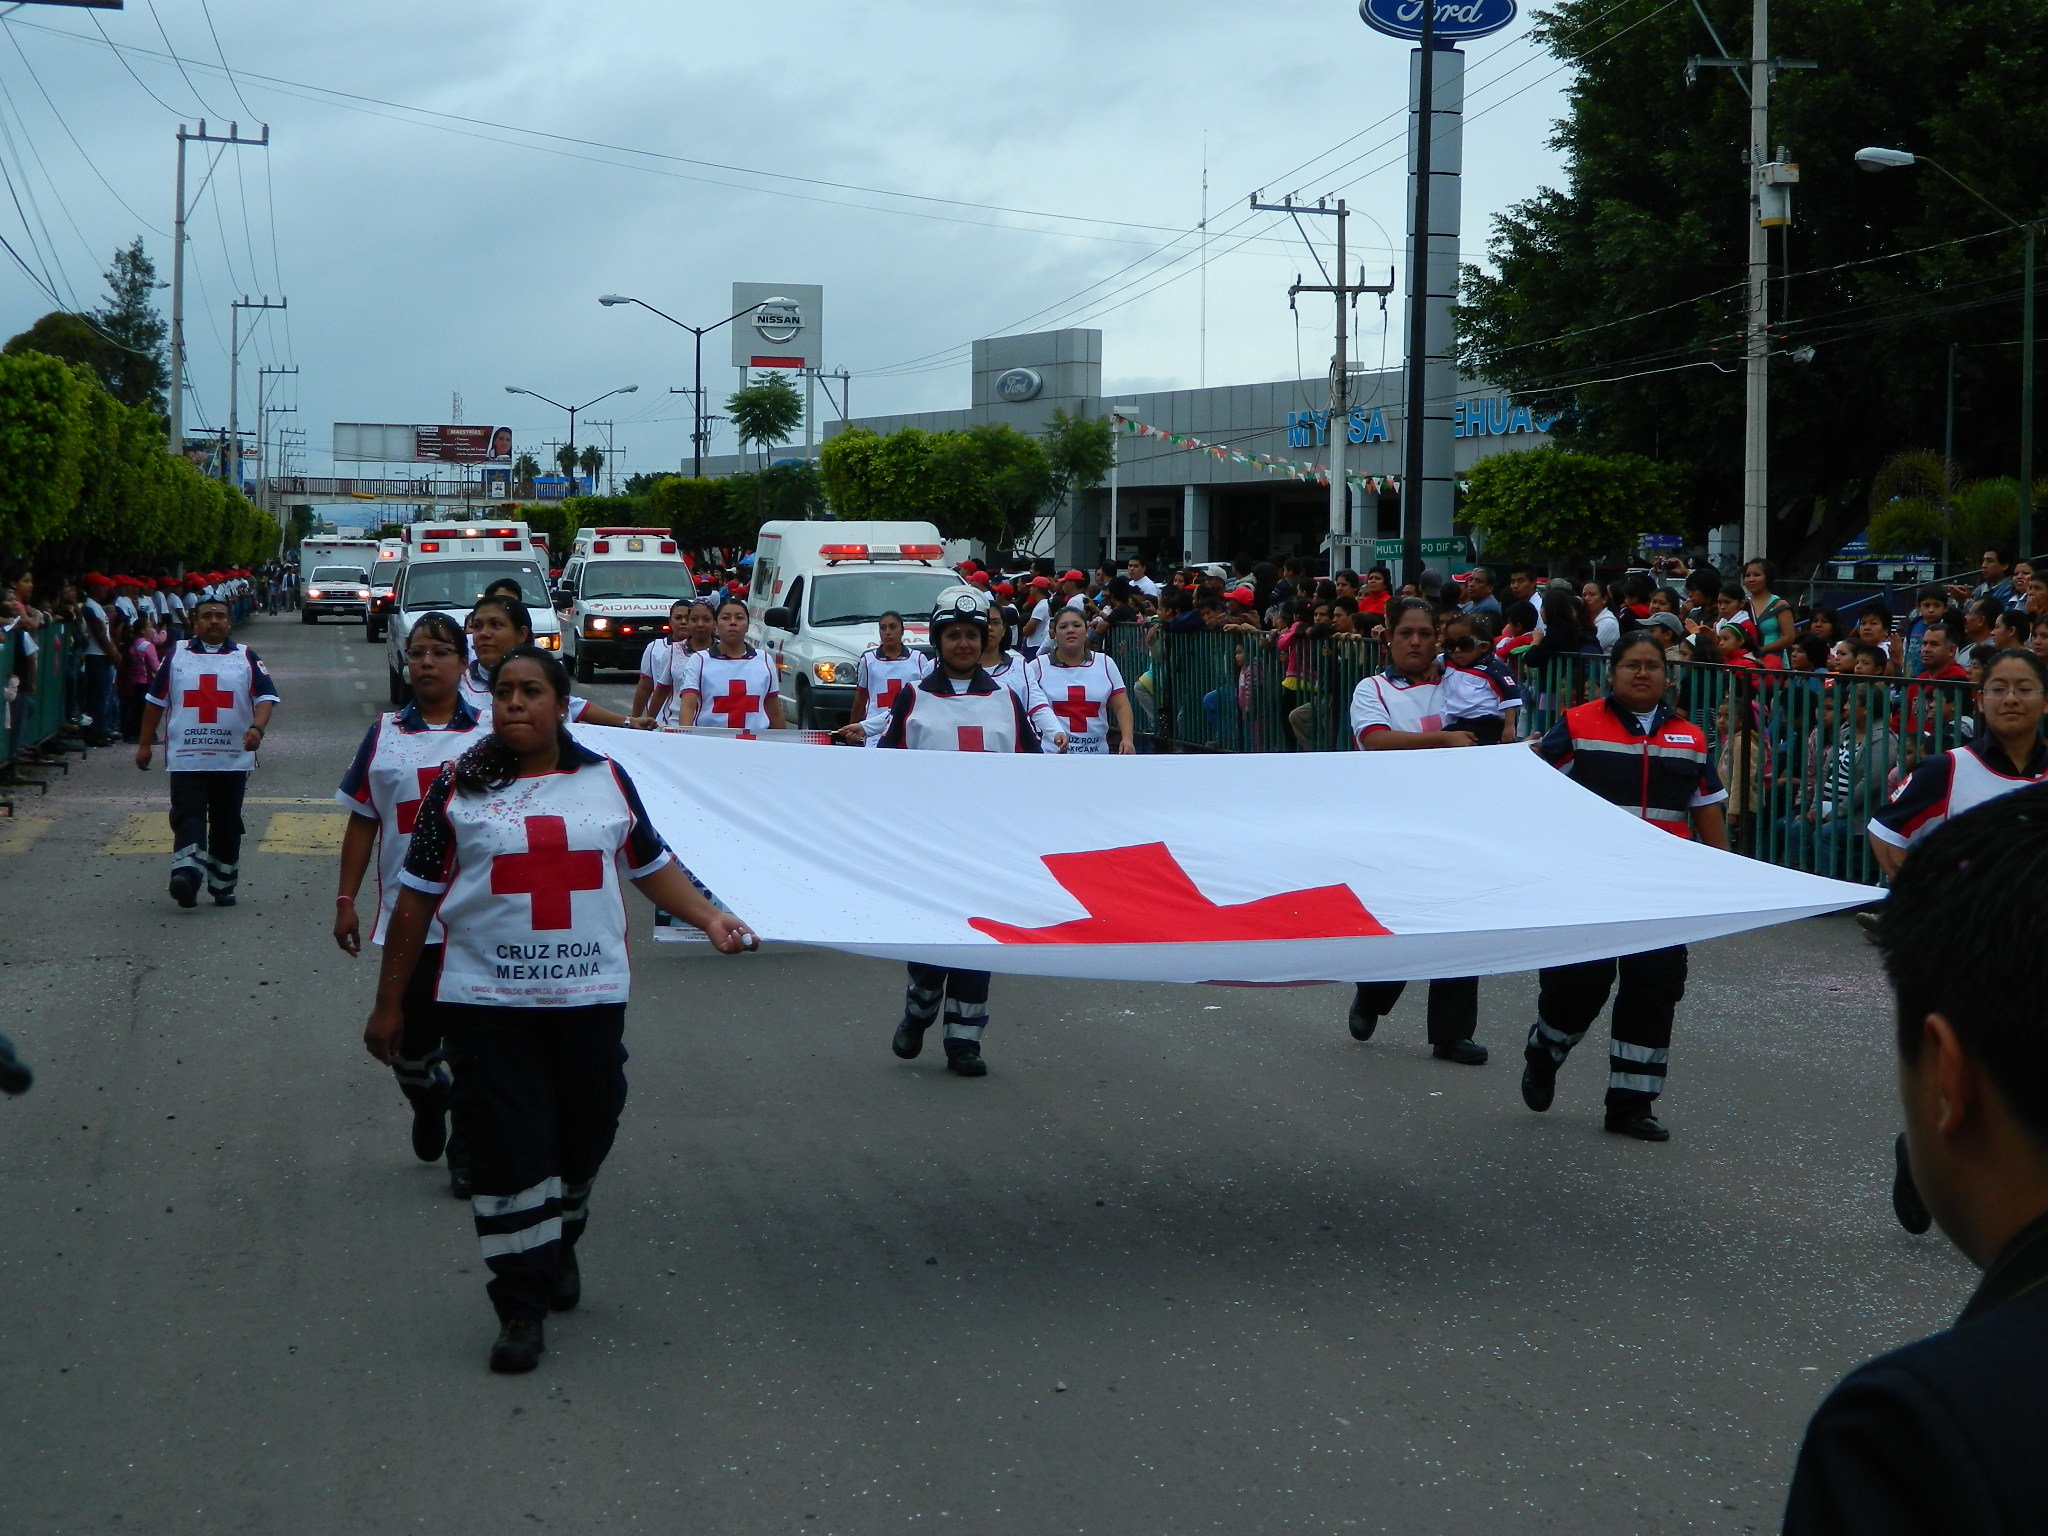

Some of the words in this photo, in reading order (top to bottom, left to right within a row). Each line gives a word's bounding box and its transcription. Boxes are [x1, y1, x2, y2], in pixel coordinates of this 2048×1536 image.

[757, 316, 800, 324] NISSAN
[1004, 376, 1027, 394] Ford
[1288, 407, 1388, 447] MYSA
[1376, 543, 1433, 554] MULTIPO
[1436, 542, 1450, 552] DIF
[184, 728, 208, 736] CRUZ
[1068, 745, 1099, 753] XICANA
[496, 944, 550, 960] CRUZ
[557, 942, 601, 958] ROJA
[496, 962, 601, 980] MEXICANA
